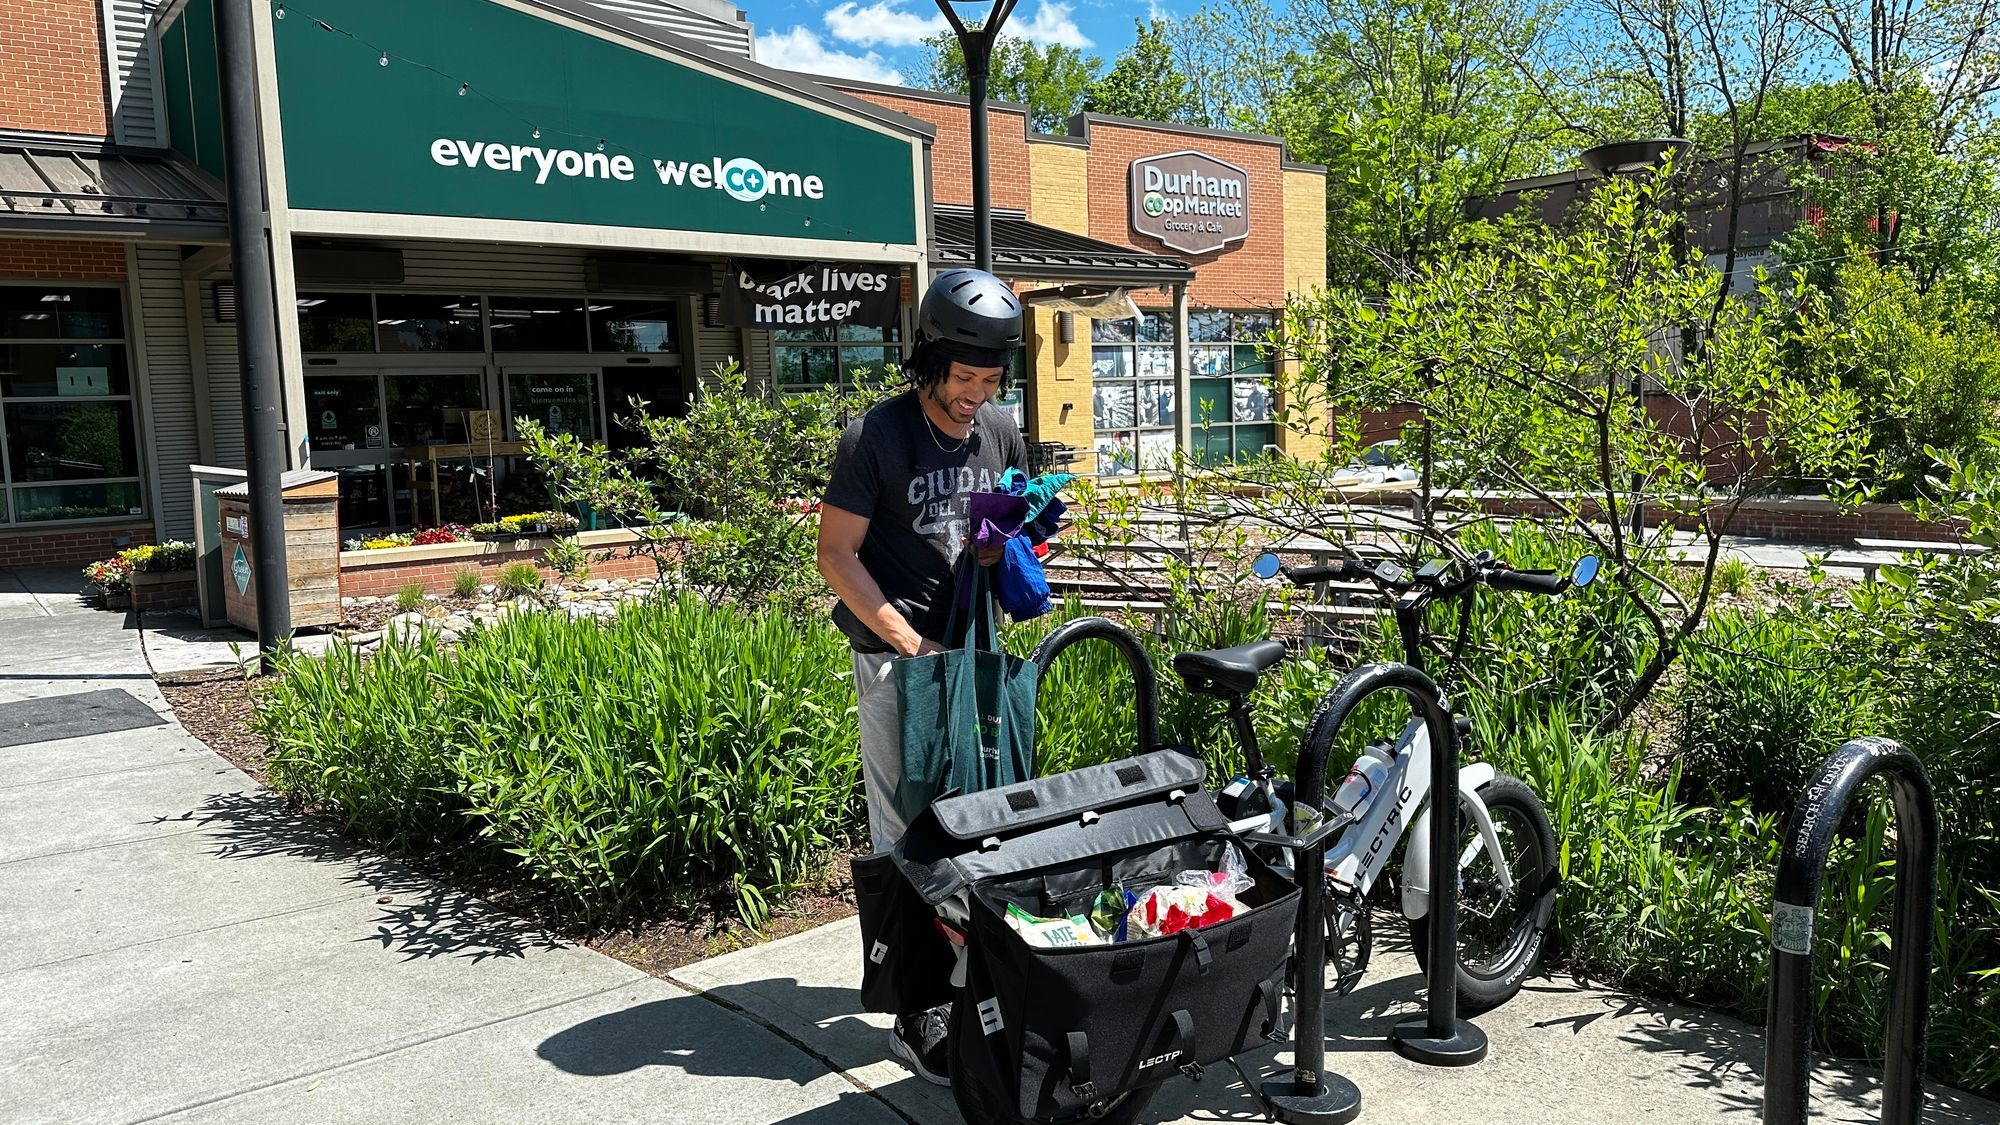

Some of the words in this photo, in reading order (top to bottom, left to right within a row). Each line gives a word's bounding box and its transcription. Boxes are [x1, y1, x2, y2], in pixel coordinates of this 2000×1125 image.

[430, 138, 634, 184] everyone
[653, 156, 824, 201] welcome
[1144, 165, 1241, 199] Durham
[1165, 219, 1196, 233] Grocery
[1199, 221, 1205, 232] &
[1733, 249, 1765, 258] asyGard
[739, 270, 814, 300] back
[821, 268, 888, 292] lives
[755, 299, 861, 323] matter
[928, 499, 956, 518] DEL
[1354, 786, 1413, 882] LECTRIC
[1796, 802, 1820, 854] SEARCH
[1042, 926, 1078, 947] LATE
[1523, 930, 1544, 966] LECTRIC
